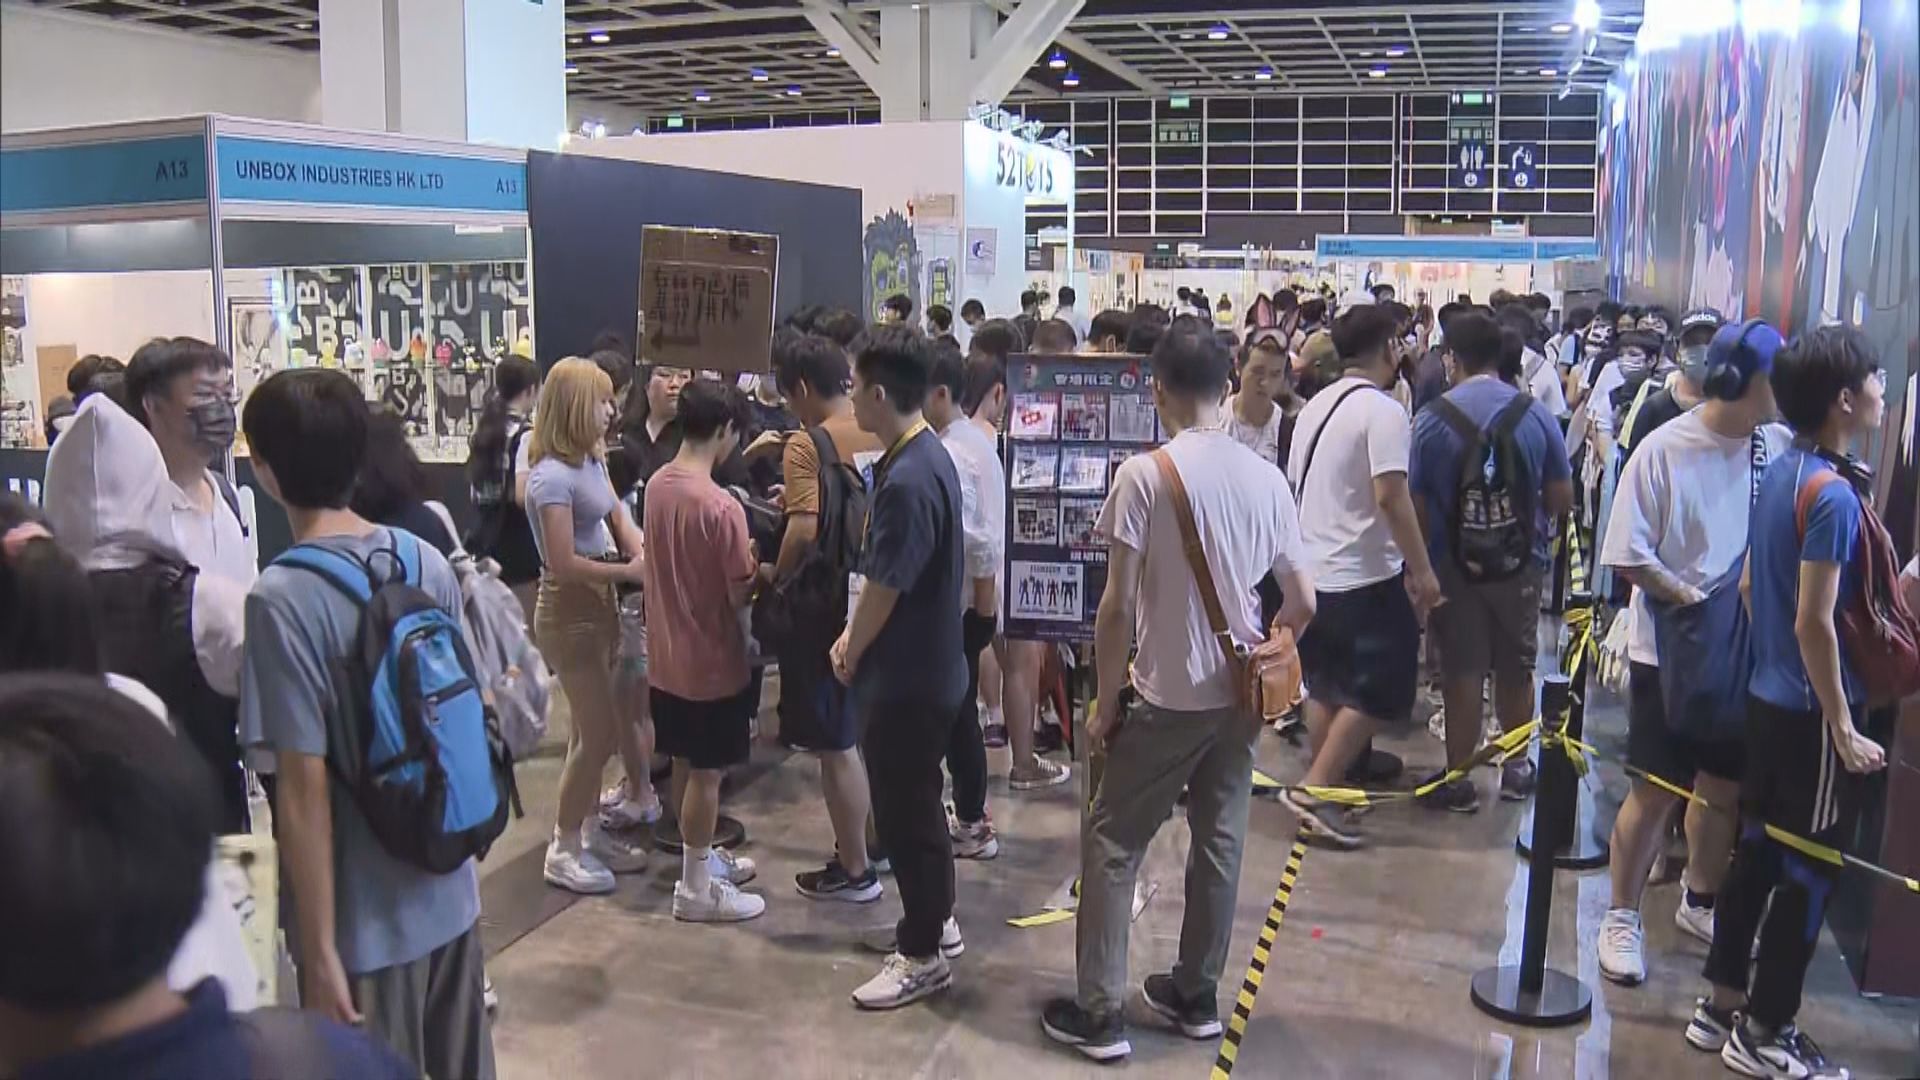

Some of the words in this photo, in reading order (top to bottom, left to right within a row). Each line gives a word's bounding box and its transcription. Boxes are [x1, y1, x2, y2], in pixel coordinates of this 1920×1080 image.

[155, 160, 188, 181] A13
[235, 160, 297, 182] UNBOX
[302, 164, 392, 188] INDUSTRIES
[396, 173, 415, 189] HK
[420, 174, 443, 189] LTD
[496, 179, 517, 194] A13
